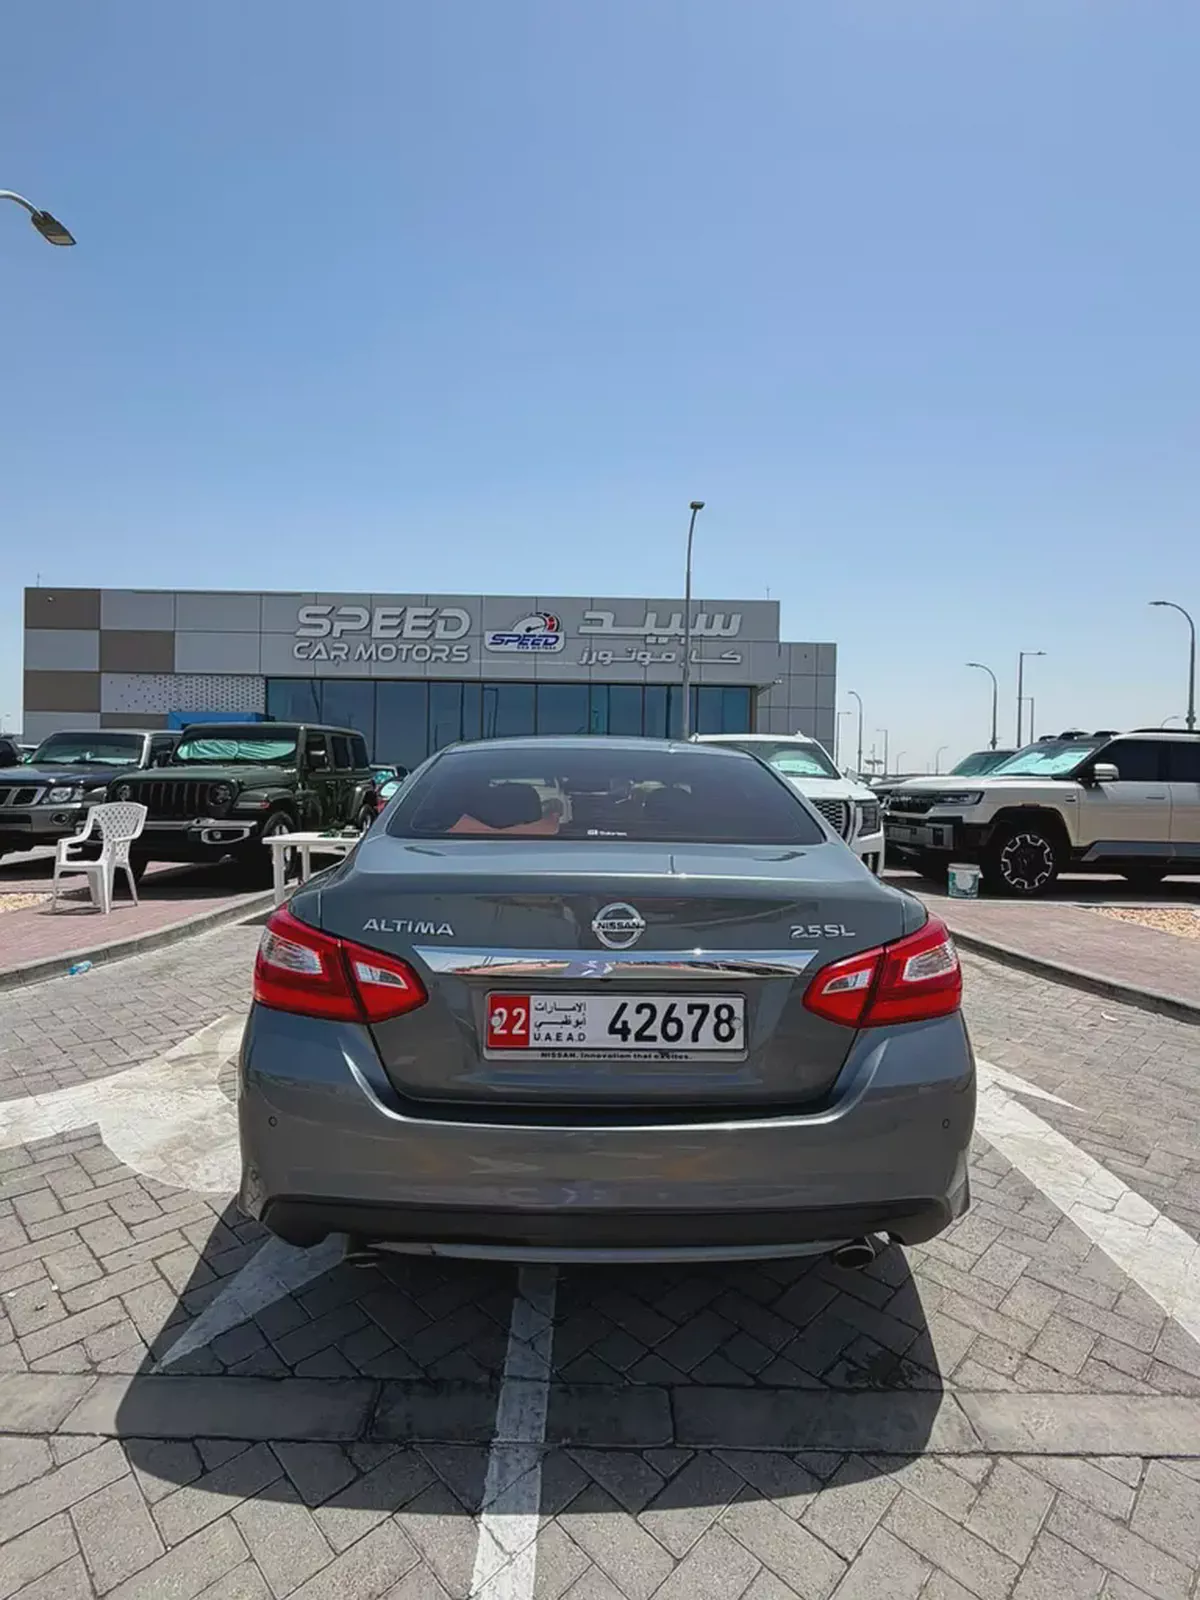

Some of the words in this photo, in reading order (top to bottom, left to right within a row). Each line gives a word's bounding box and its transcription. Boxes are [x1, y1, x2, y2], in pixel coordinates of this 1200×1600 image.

[295, 605, 471, 639] SPEED
[578, 611, 742, 644] سبيد
[489, 634, 560, 646] SPEED
[293, 642, 349, 660] CAR
[354, 643, 470, 663] MOTORS
[578, 648, 676, 666] موتورز
[362, 918, 454, 936] ALTIMA
[597, 921, 640, 929] NISSAN
[493, 1007, 526, 1035] 22
[607, 1002, 736, 1042] 42678
